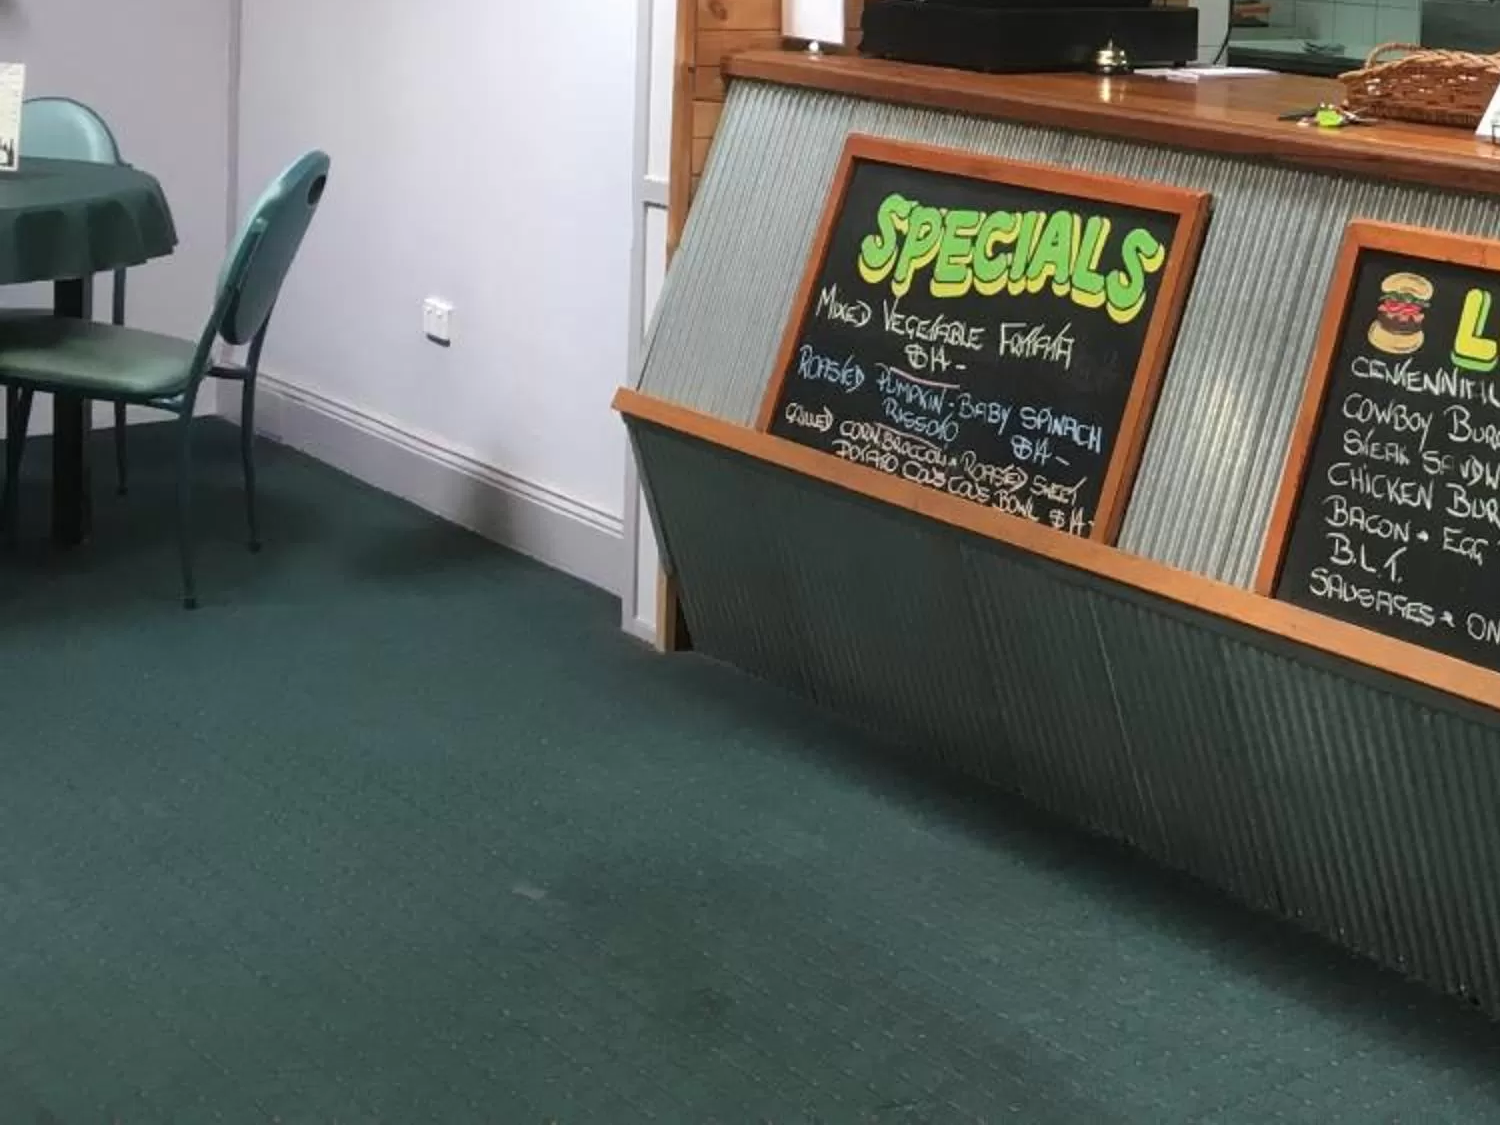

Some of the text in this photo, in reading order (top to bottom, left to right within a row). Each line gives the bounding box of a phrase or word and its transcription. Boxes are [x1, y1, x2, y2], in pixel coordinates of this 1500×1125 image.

[858, 193, 1164, 324] SPECIALS
[816, 283, 872, 327] MIXED
[884, 299, 985, 350] VEGETABLE
[798, 344, 1102, 453] ROASTED PUMPKIN BABY SPINACH
[1342, 393, 1434, 452] COWBOY
[962, 450, 1028, 494] ROASTED
[1030, 474, 1088, 506] SWEET
[1343, 428, 1410, 466] STEAK
[832, 439, 898, 472] POTATO
[902, 460, 946, 487] COUS
[948, 476, 990, 502] COUS
[993, 488, 1040, 522] BOWL
[1328, 463, 1434, 511] CHICKEN
[1323, 495, 1411, 543] BACON
[1443, 527, 1488, 566] EGG
[1310, 568, 1436, 627] SAUSAGES
